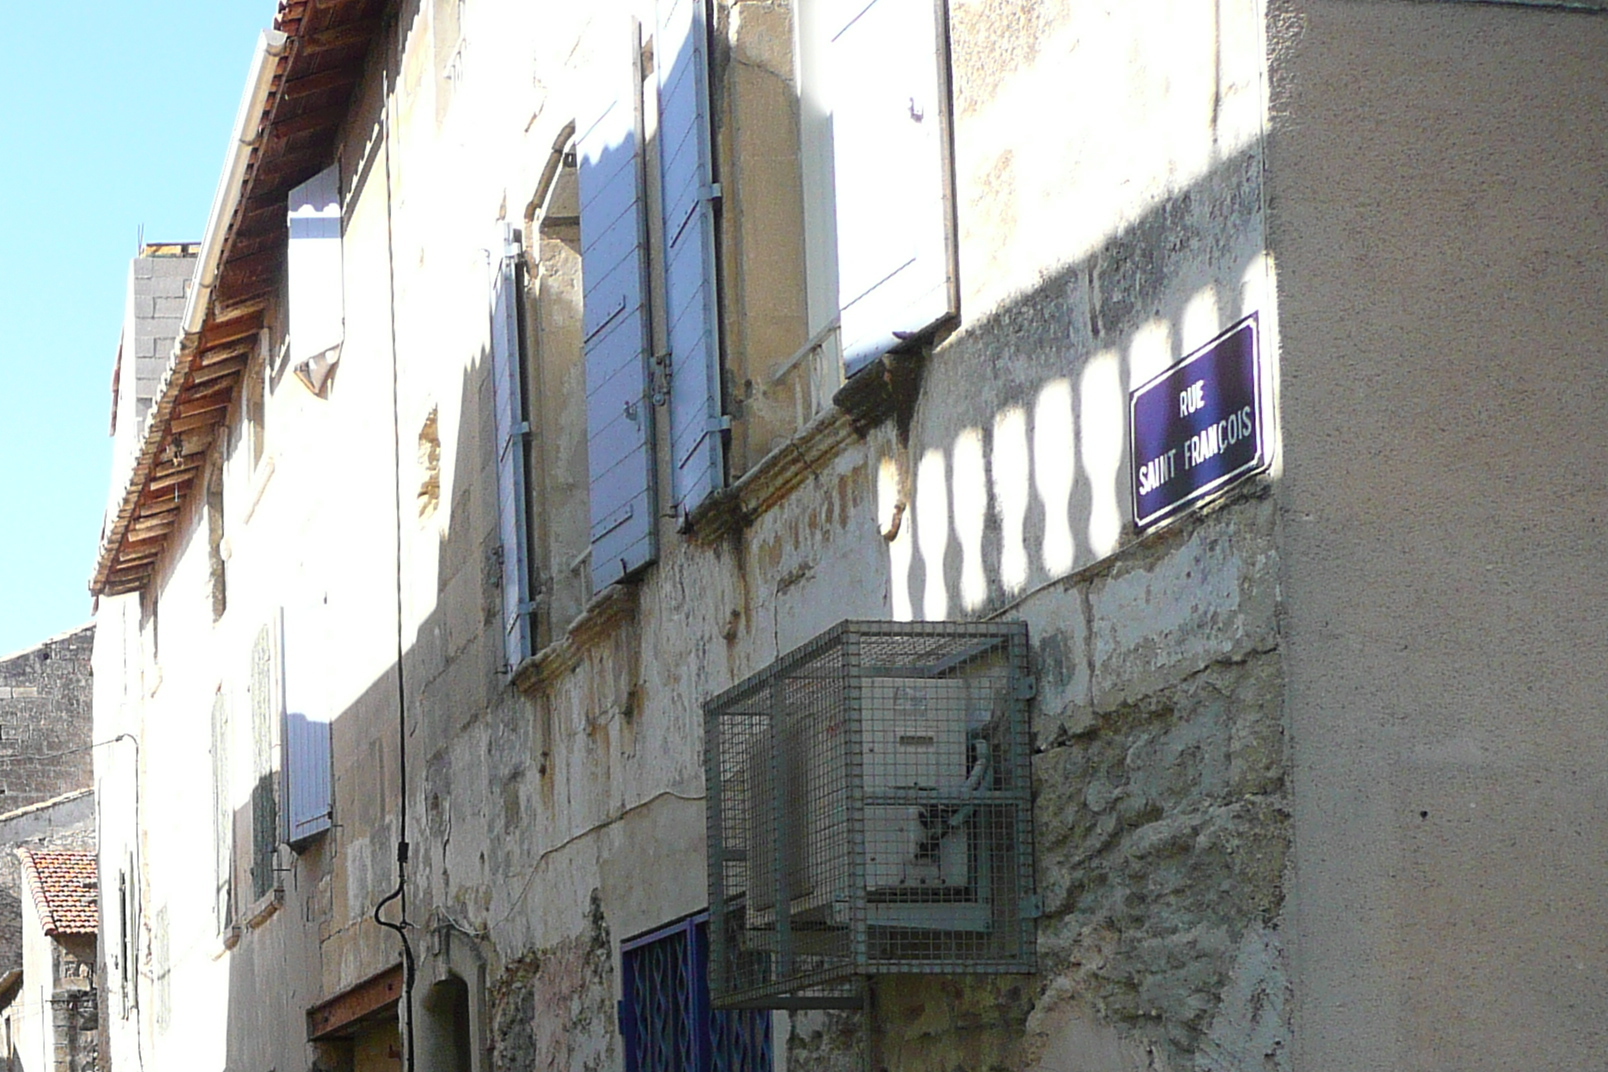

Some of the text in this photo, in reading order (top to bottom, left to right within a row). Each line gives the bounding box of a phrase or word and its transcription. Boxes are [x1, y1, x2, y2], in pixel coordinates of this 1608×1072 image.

[1179, 379, 1205, 418] RUE
[1139, 405, 1252, 495] SAINT FRANÇOIS
